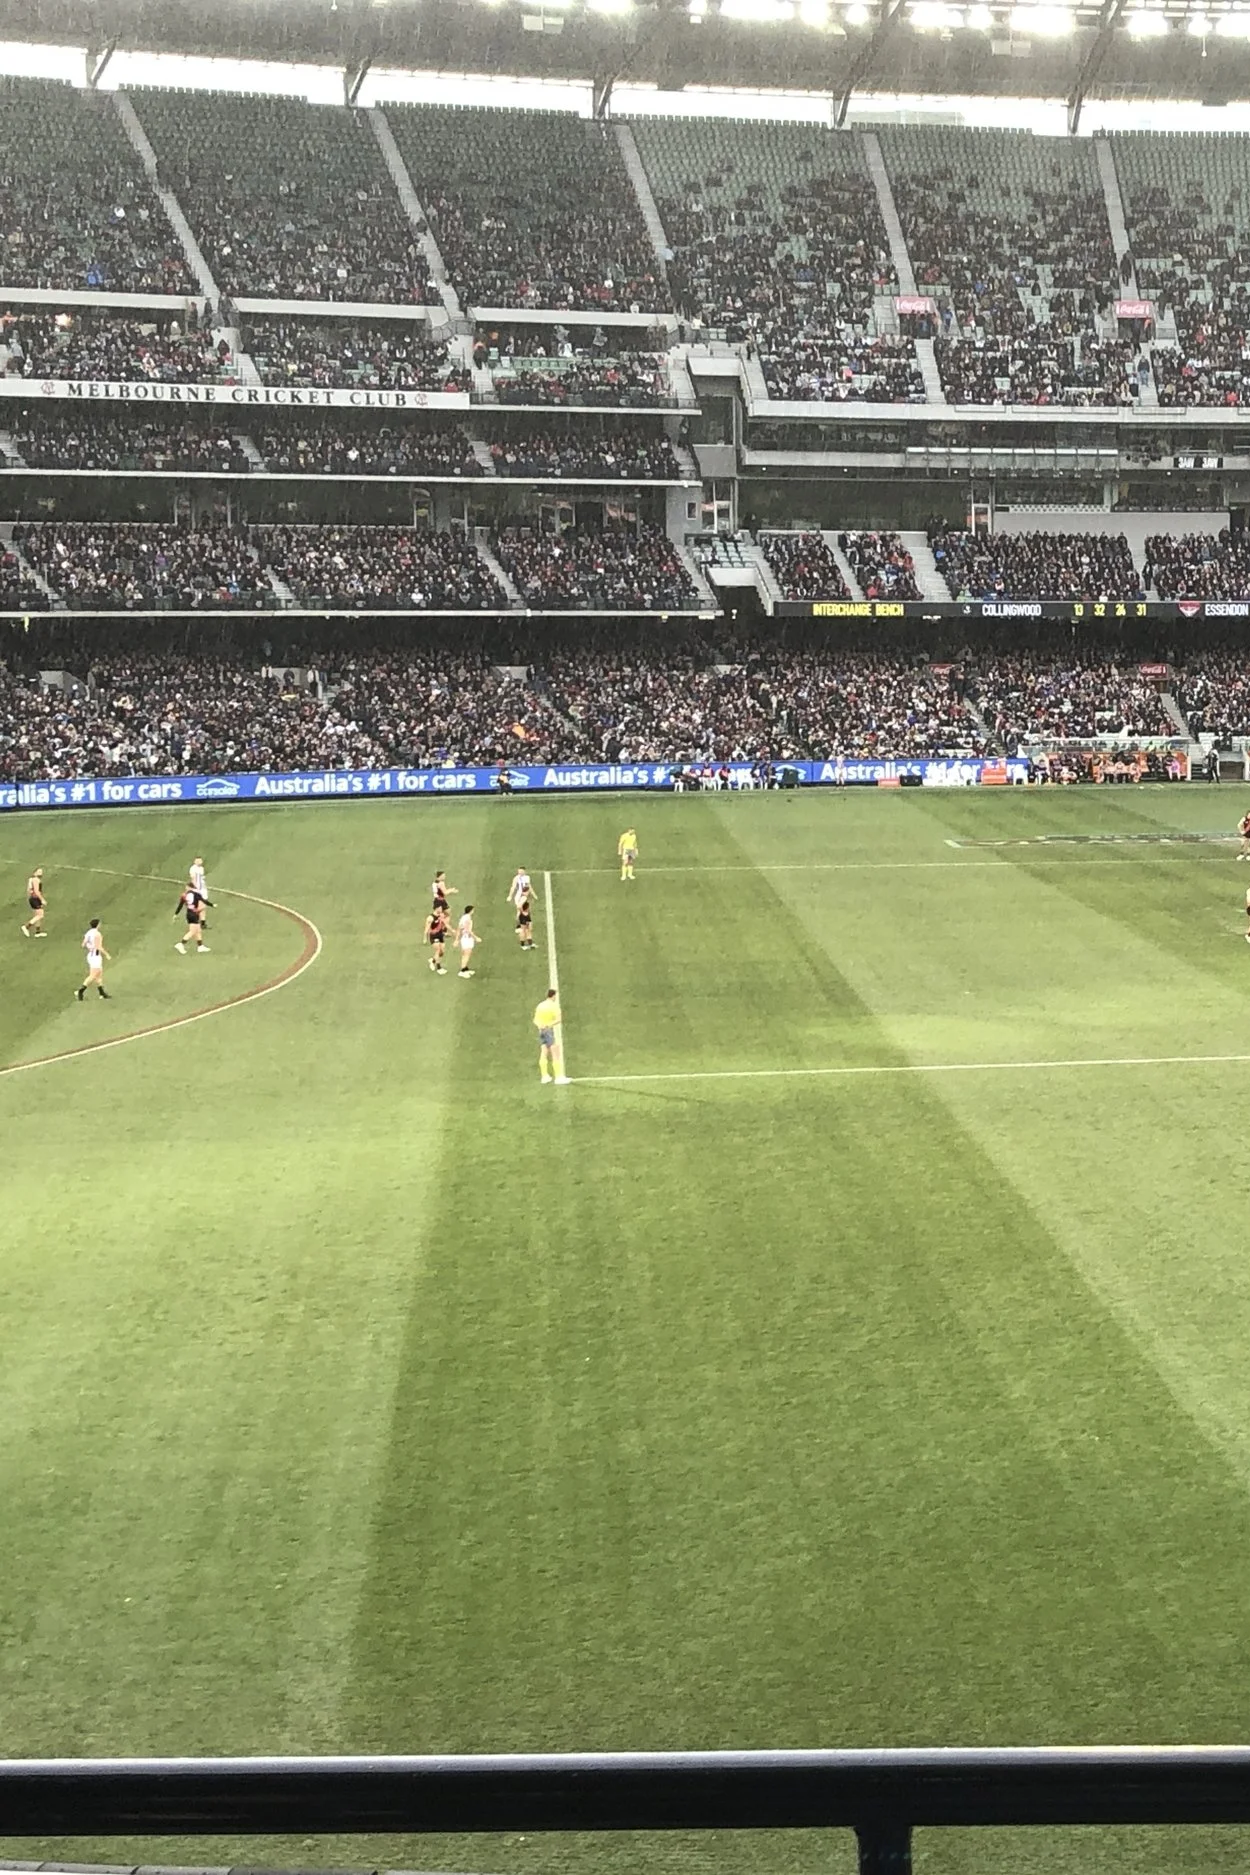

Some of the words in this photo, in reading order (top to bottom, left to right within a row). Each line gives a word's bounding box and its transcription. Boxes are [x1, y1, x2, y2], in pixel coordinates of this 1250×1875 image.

[67, 383, 216, 401] MELBOURNE
[231, 388, 334, 404] CRICKET
[349, 391, 407, 407] CLUB
[813, 603, 872, 616] INTERCHANGE
[875, 603, 904, 616] BENCH
[982, 604, 1042, 616] COLLINGWOOD
[1205, 603, 1249, 616] ESSENDON
[254, 773, 363, 795] Australia's
[367, 774, 392, 791] #1
[397, 772, 428, 789] for
[432, 773, 476, 788] cars
[543, 766, 648, 786] Australia's
[71, 783, 96, 802] #1
[102, 780, 134, 801] for
[138, 782, 182, 799] cars
